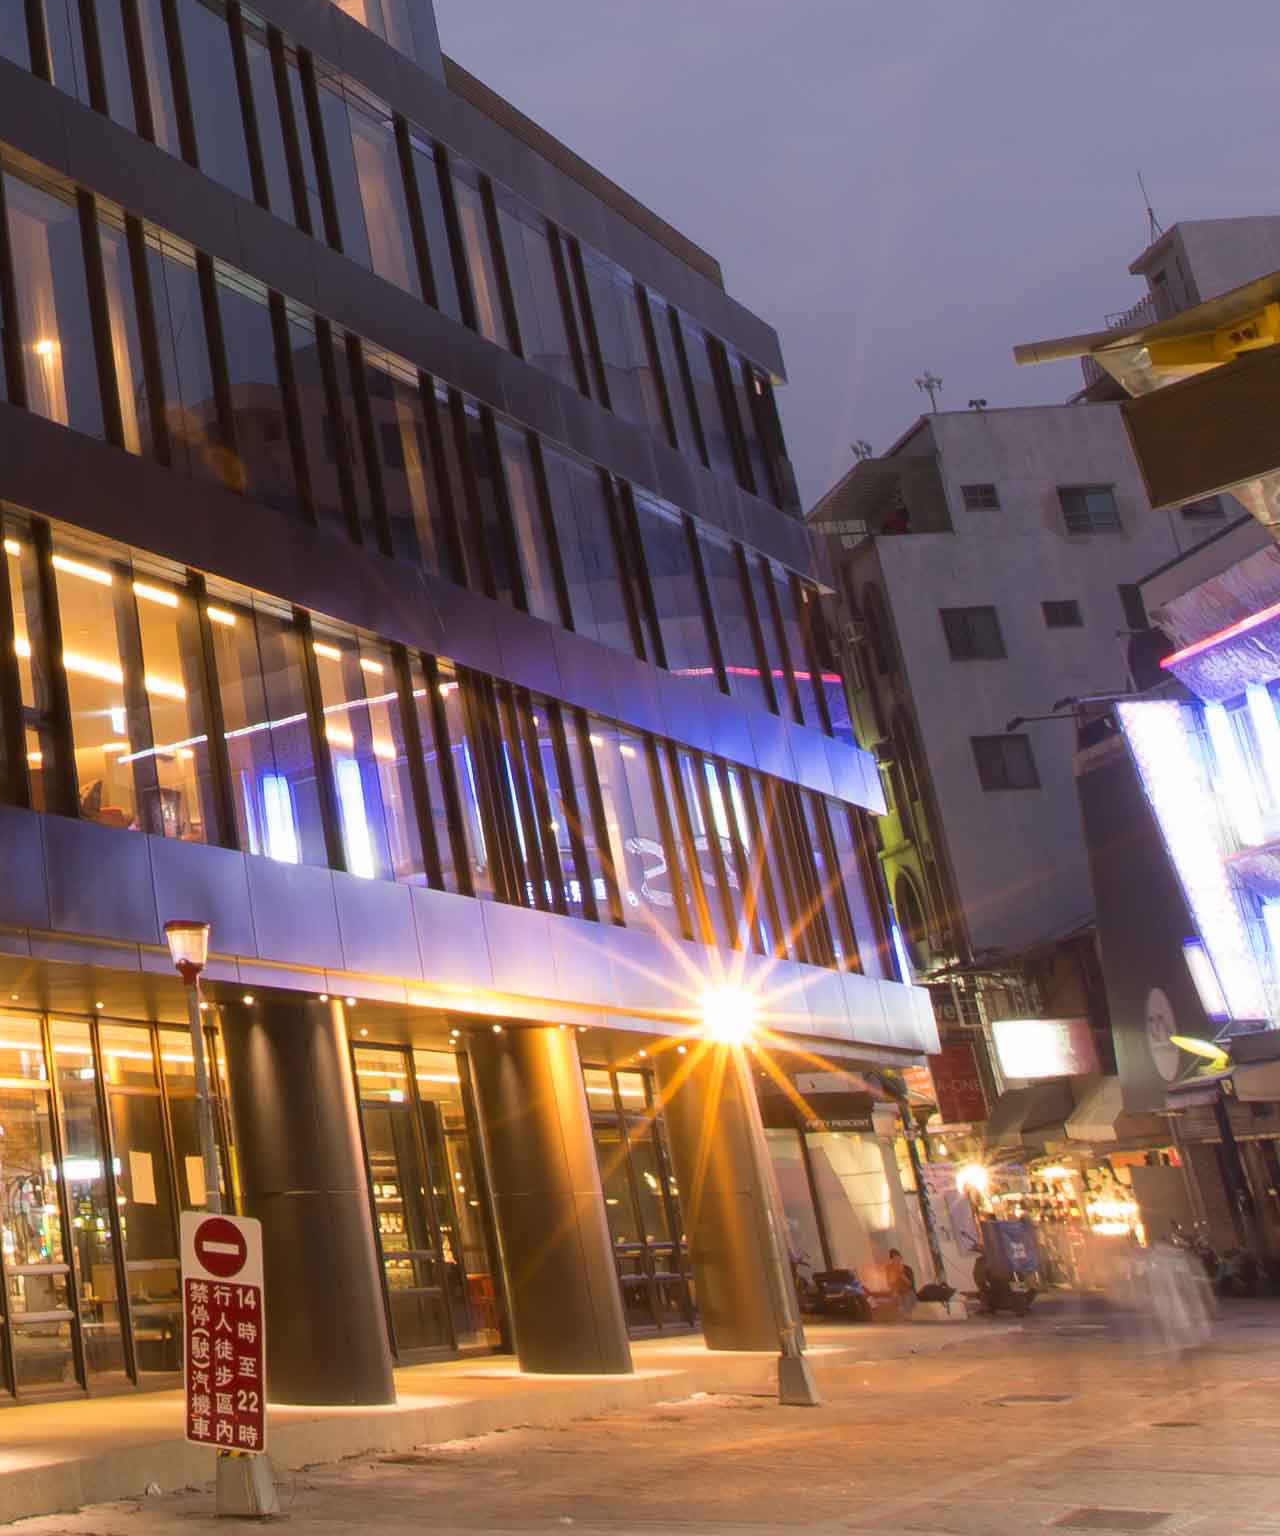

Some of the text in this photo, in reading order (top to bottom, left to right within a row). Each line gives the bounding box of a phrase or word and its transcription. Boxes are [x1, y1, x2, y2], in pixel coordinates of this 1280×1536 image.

[190, 1282, 210, 1439] 禁停(駛)汽機車
[213, 1285, 234, 1444] 行人徒步區內
